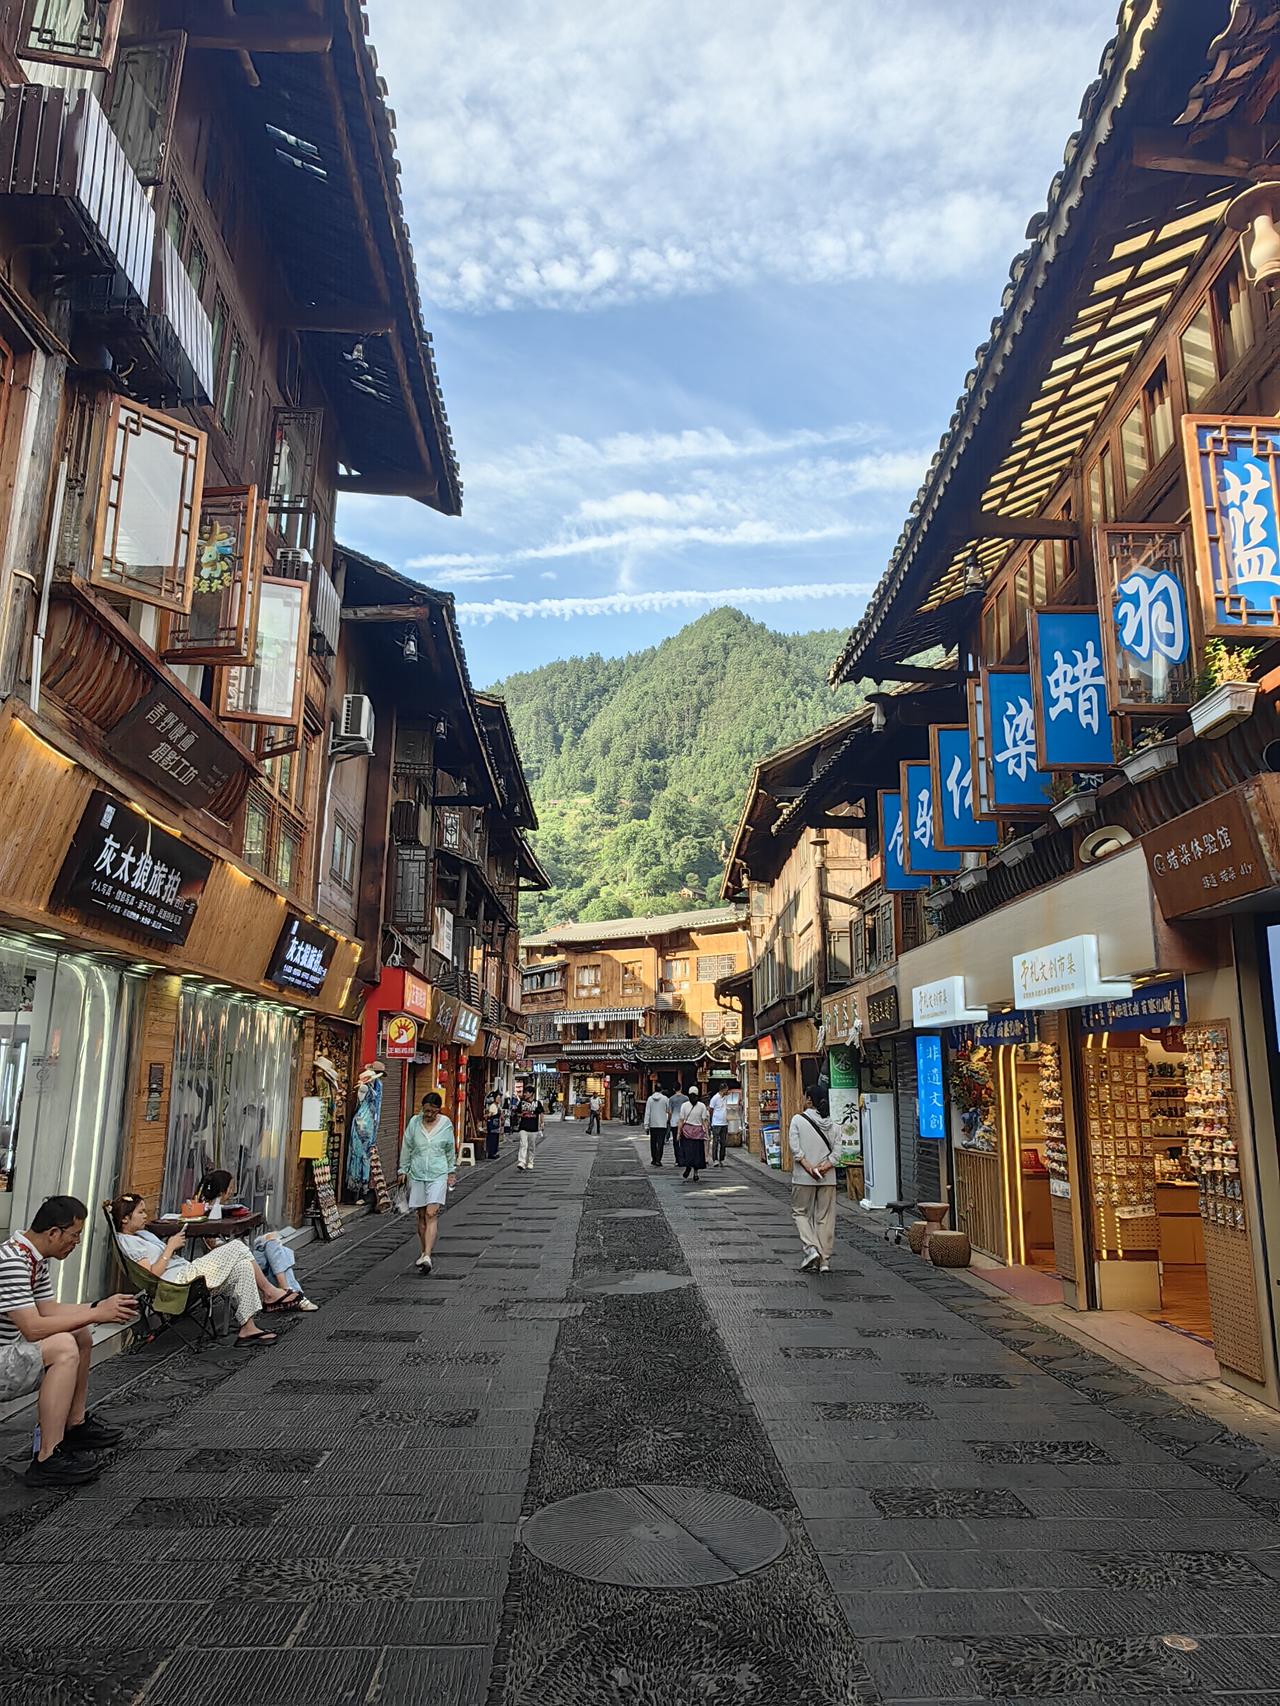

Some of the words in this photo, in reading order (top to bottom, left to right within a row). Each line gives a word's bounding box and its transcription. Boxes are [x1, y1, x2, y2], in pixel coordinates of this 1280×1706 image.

[1215, 463, 1280, 592] 蓝
[1117, 575, 1183, 659] 羽
[1046, 640, 1106, 735] 蜡
[147, 741, 199, 786] 摄影工坊
[994, 695, 1037, 782] 染
[93, 833, 182, 907] 灰太狼旅拍
[1166, 826, 1232, 870] 蜡染体验馆
[836, 1102, 859, 1125] 茶
